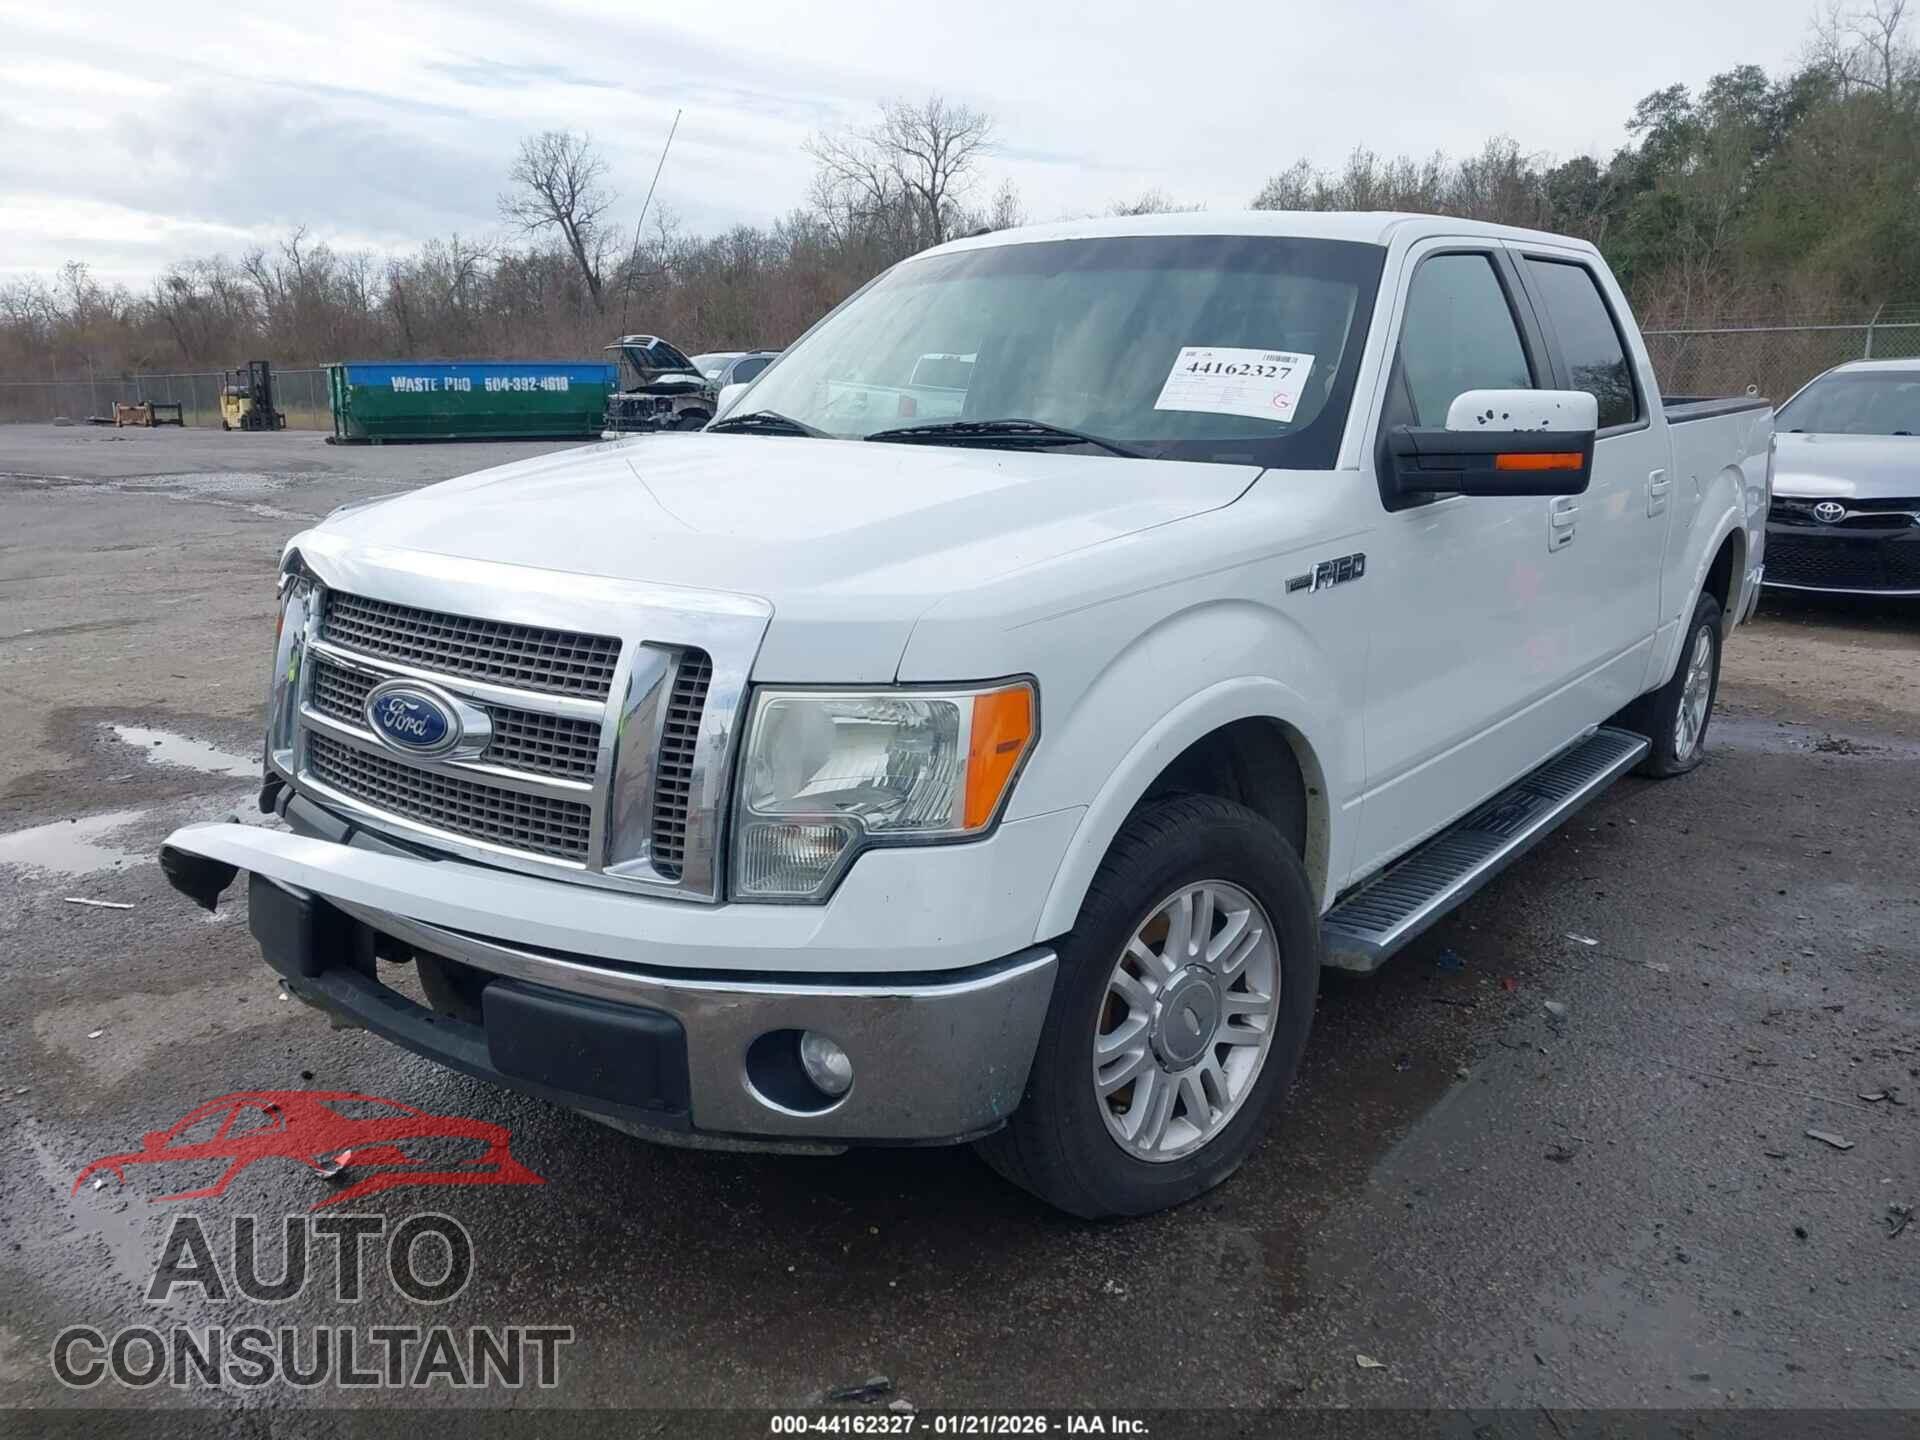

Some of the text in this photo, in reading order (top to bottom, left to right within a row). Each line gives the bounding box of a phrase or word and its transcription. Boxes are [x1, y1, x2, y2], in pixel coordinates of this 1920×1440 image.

[1186, 361, 1292, 380] 44162327
[391, 376, 438, 392] WASTE
[381, 698, 430, 736] Ford
